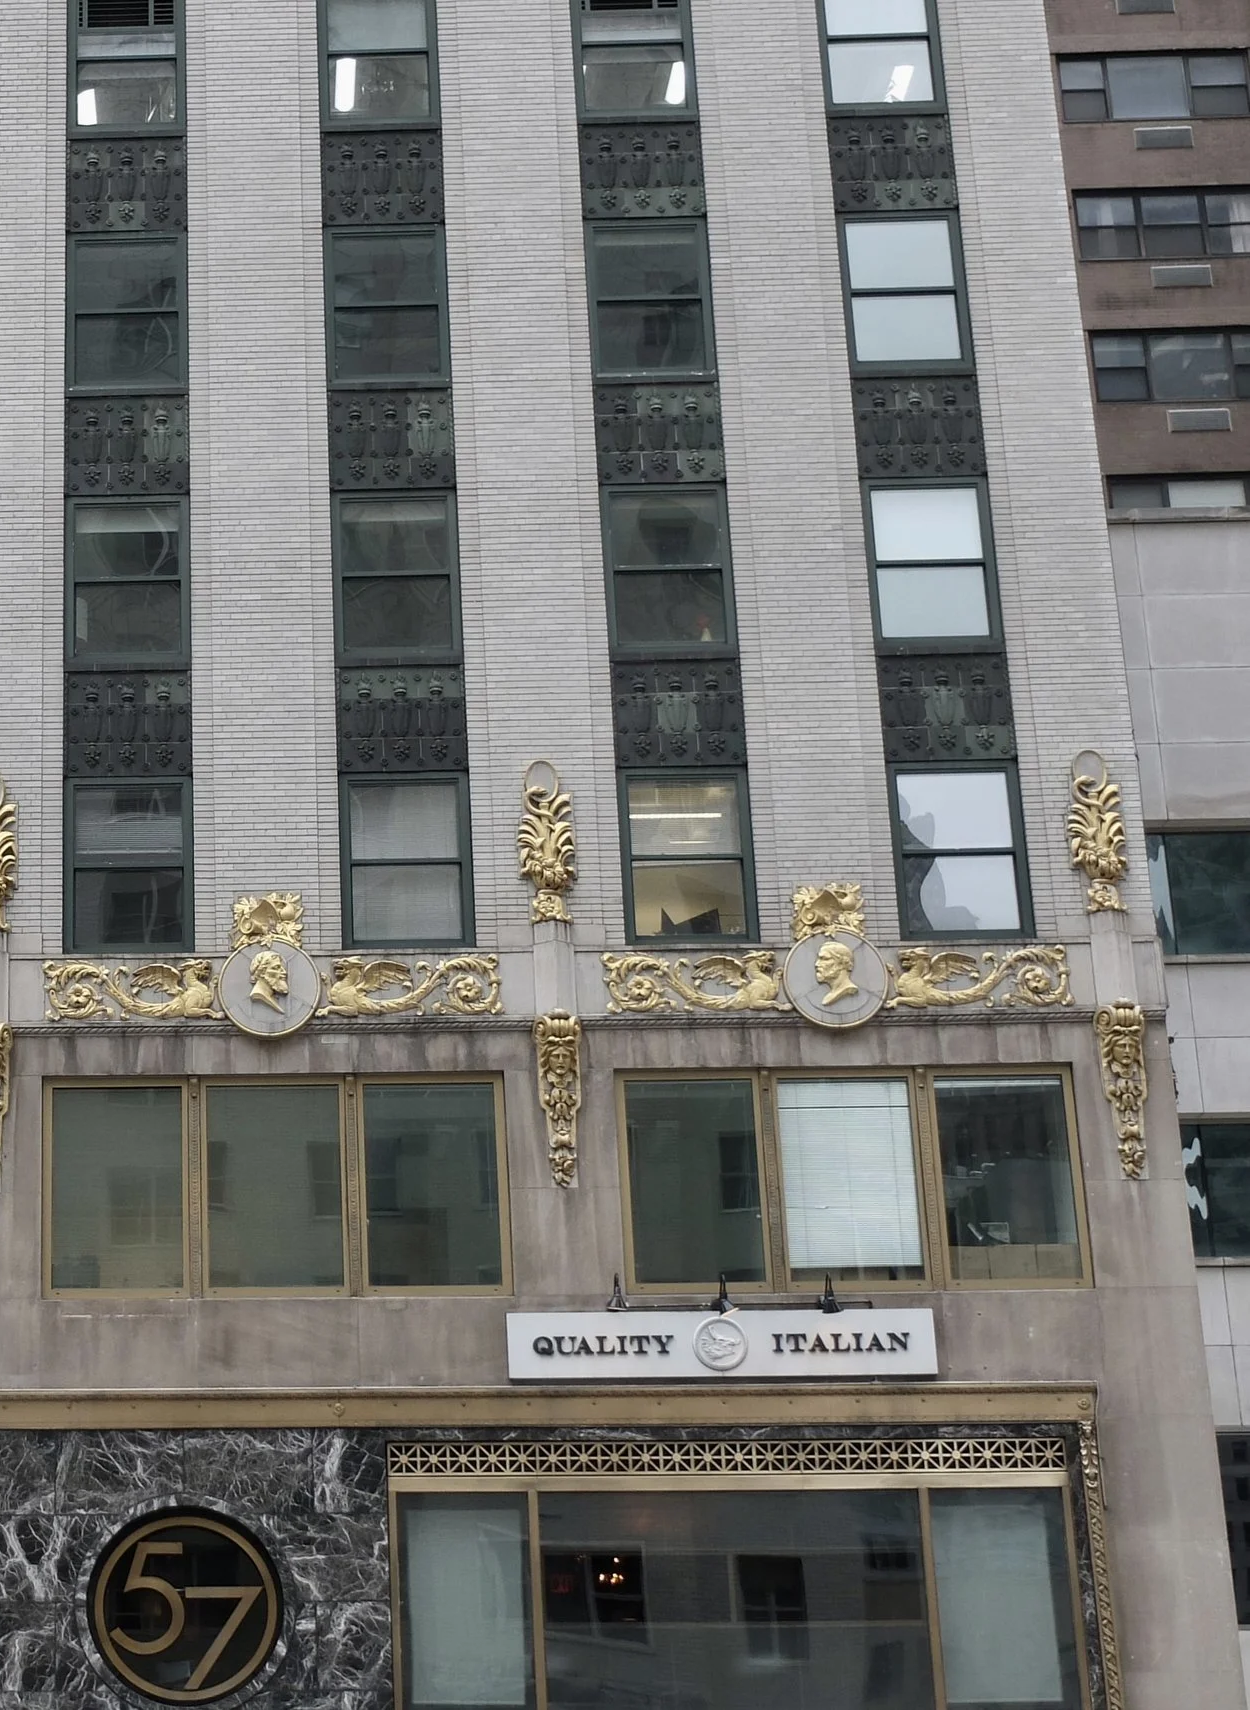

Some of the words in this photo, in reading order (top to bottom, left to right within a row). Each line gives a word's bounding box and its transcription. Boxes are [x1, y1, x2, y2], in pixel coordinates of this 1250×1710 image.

[532, 1334, 674, 1357] QUALITY
[771, 1332, 910, 1354] ITALIAN
[110, 1542, 264, 1690] 57
